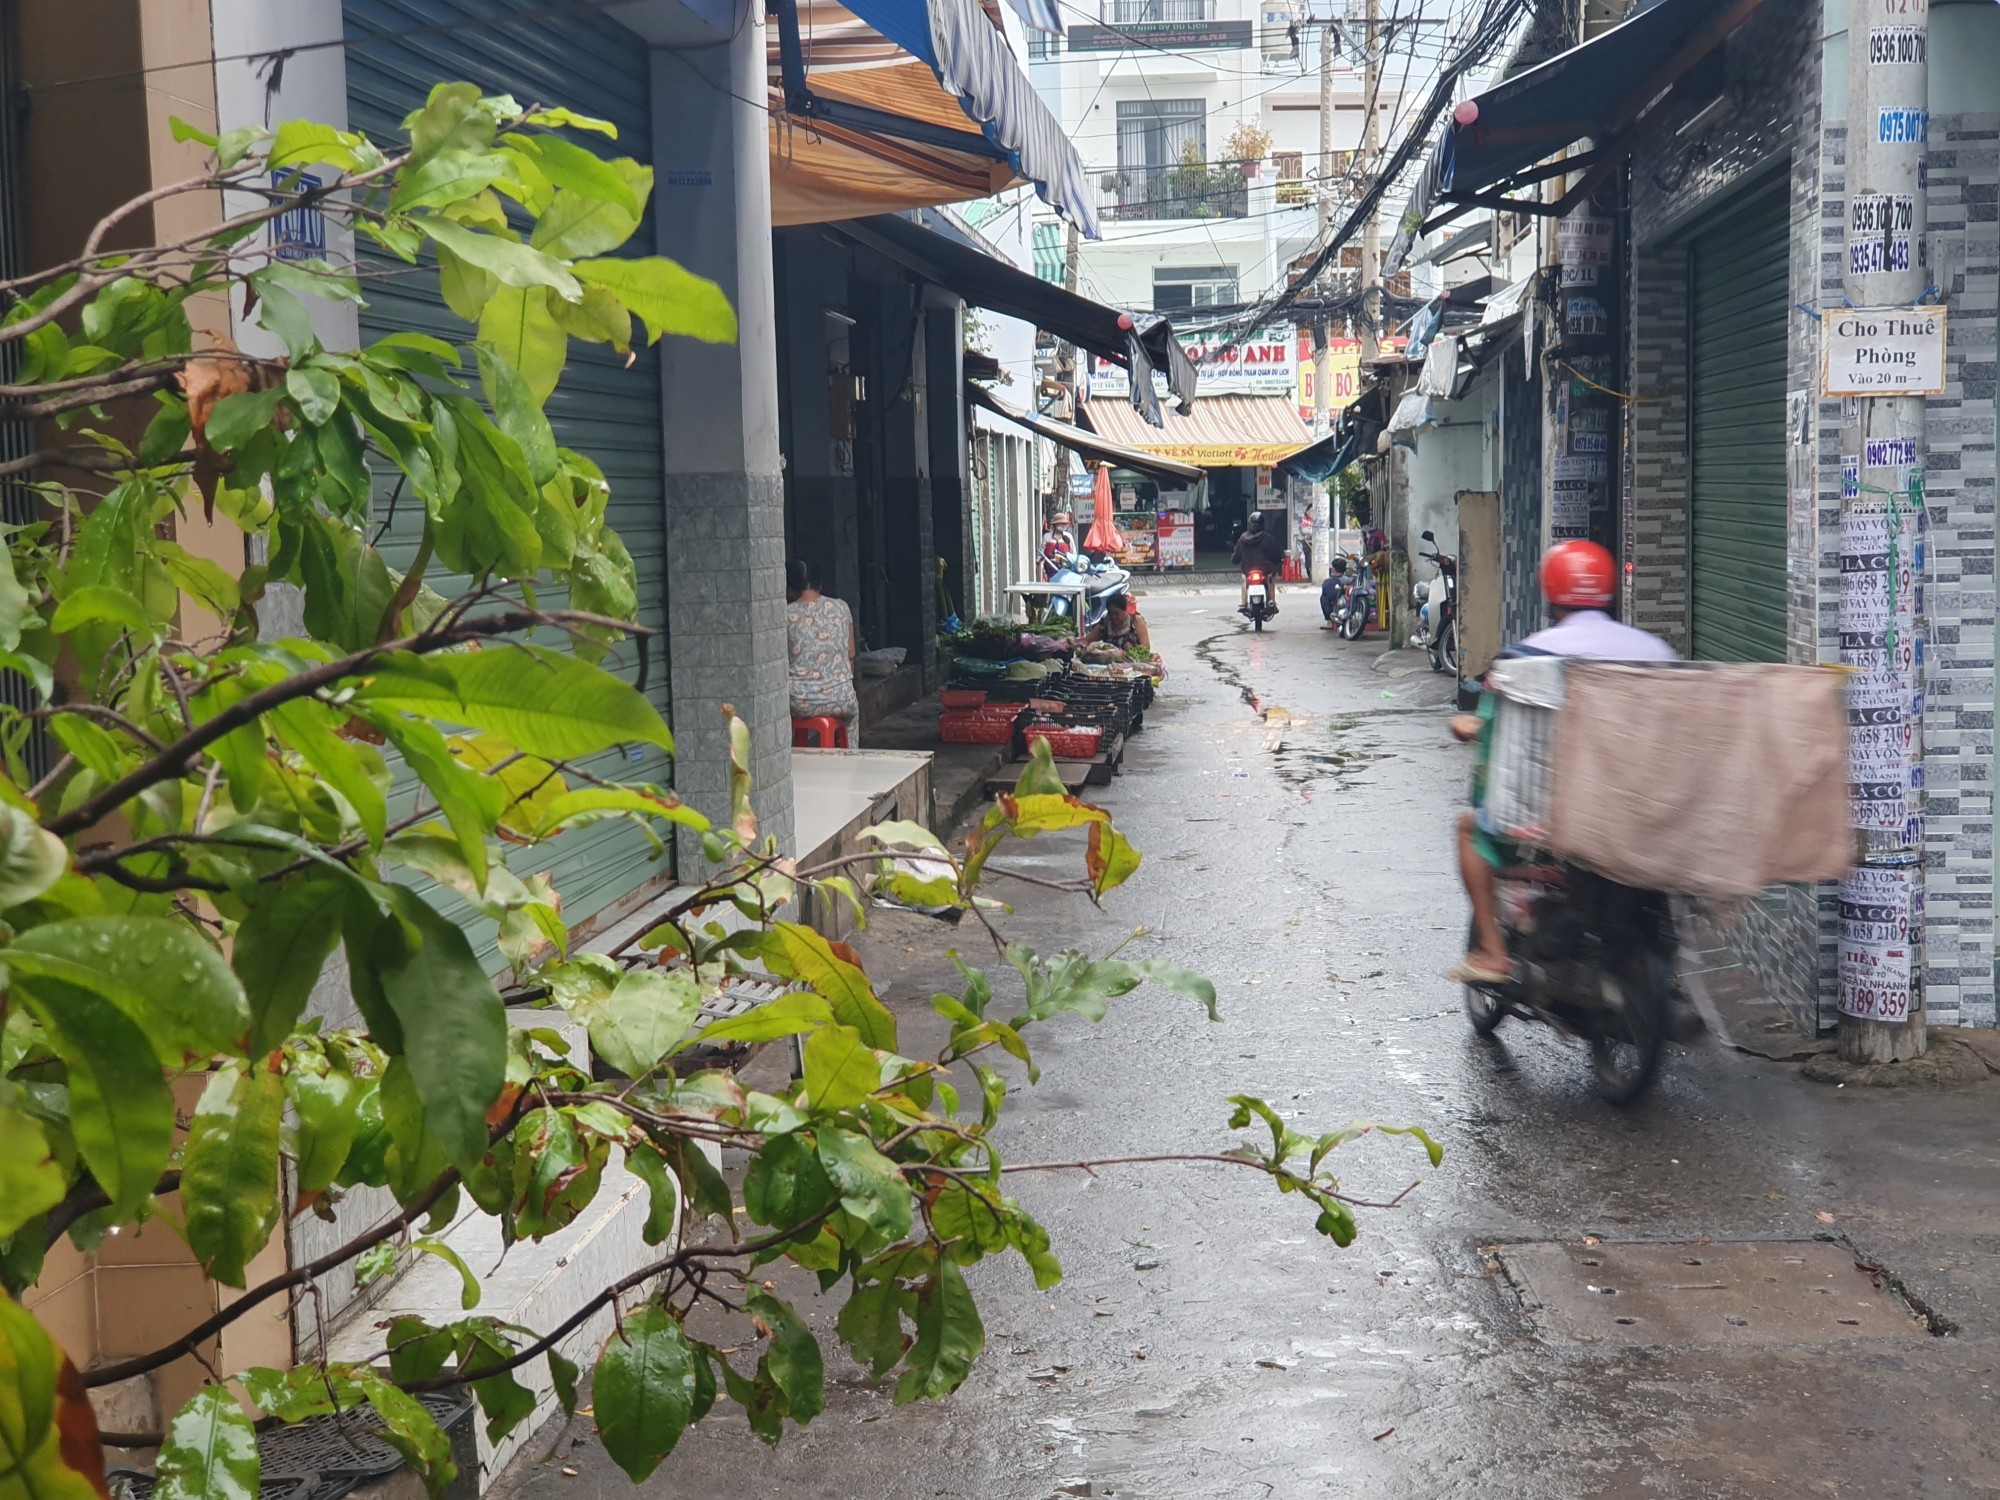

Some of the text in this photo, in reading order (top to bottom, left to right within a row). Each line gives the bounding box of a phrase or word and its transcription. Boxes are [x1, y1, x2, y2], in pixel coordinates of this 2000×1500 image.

[1838, 318, 1935, 337] Cho Thuê
[1244, 344, 1286, 363] ANH
[1855, 348, 1916, 367] Phòng
[1848, 373, 1873, 384] Vào
[1876, 373, 1891, 384] 20
[1850, 519, 1869, 531] VAY
[1846, 554, 1866, 570] LÀ
[1858, 573, 1877, 590] 658
[1881, 573, 1901, 589] 20
[1849, 598, 1869, 609] VAY
[1845, 632, 1866, 647] LÀ
[1858, 651, 1877, 668] 658
[1881, 649, 1901, 667] 20
[1847, 709, 1868, 724] LÀ
[1860, 728, 1879, 744] 658
[1851, 749, 1871, 759] VAY
[1848, 783, 1868, 797] LÀ
[1860, 802, 1880, 819] 658
[1843, 903, 1863, 918] LÀ
[1854, 924, 1873, 939] 658
[1877, 925, 1897, 940] 210
[1870, 979, 1907, 991] NHANH
[1851, 985, 1874, 1013] 189
[1878, 990, 1907, 1016] 359
